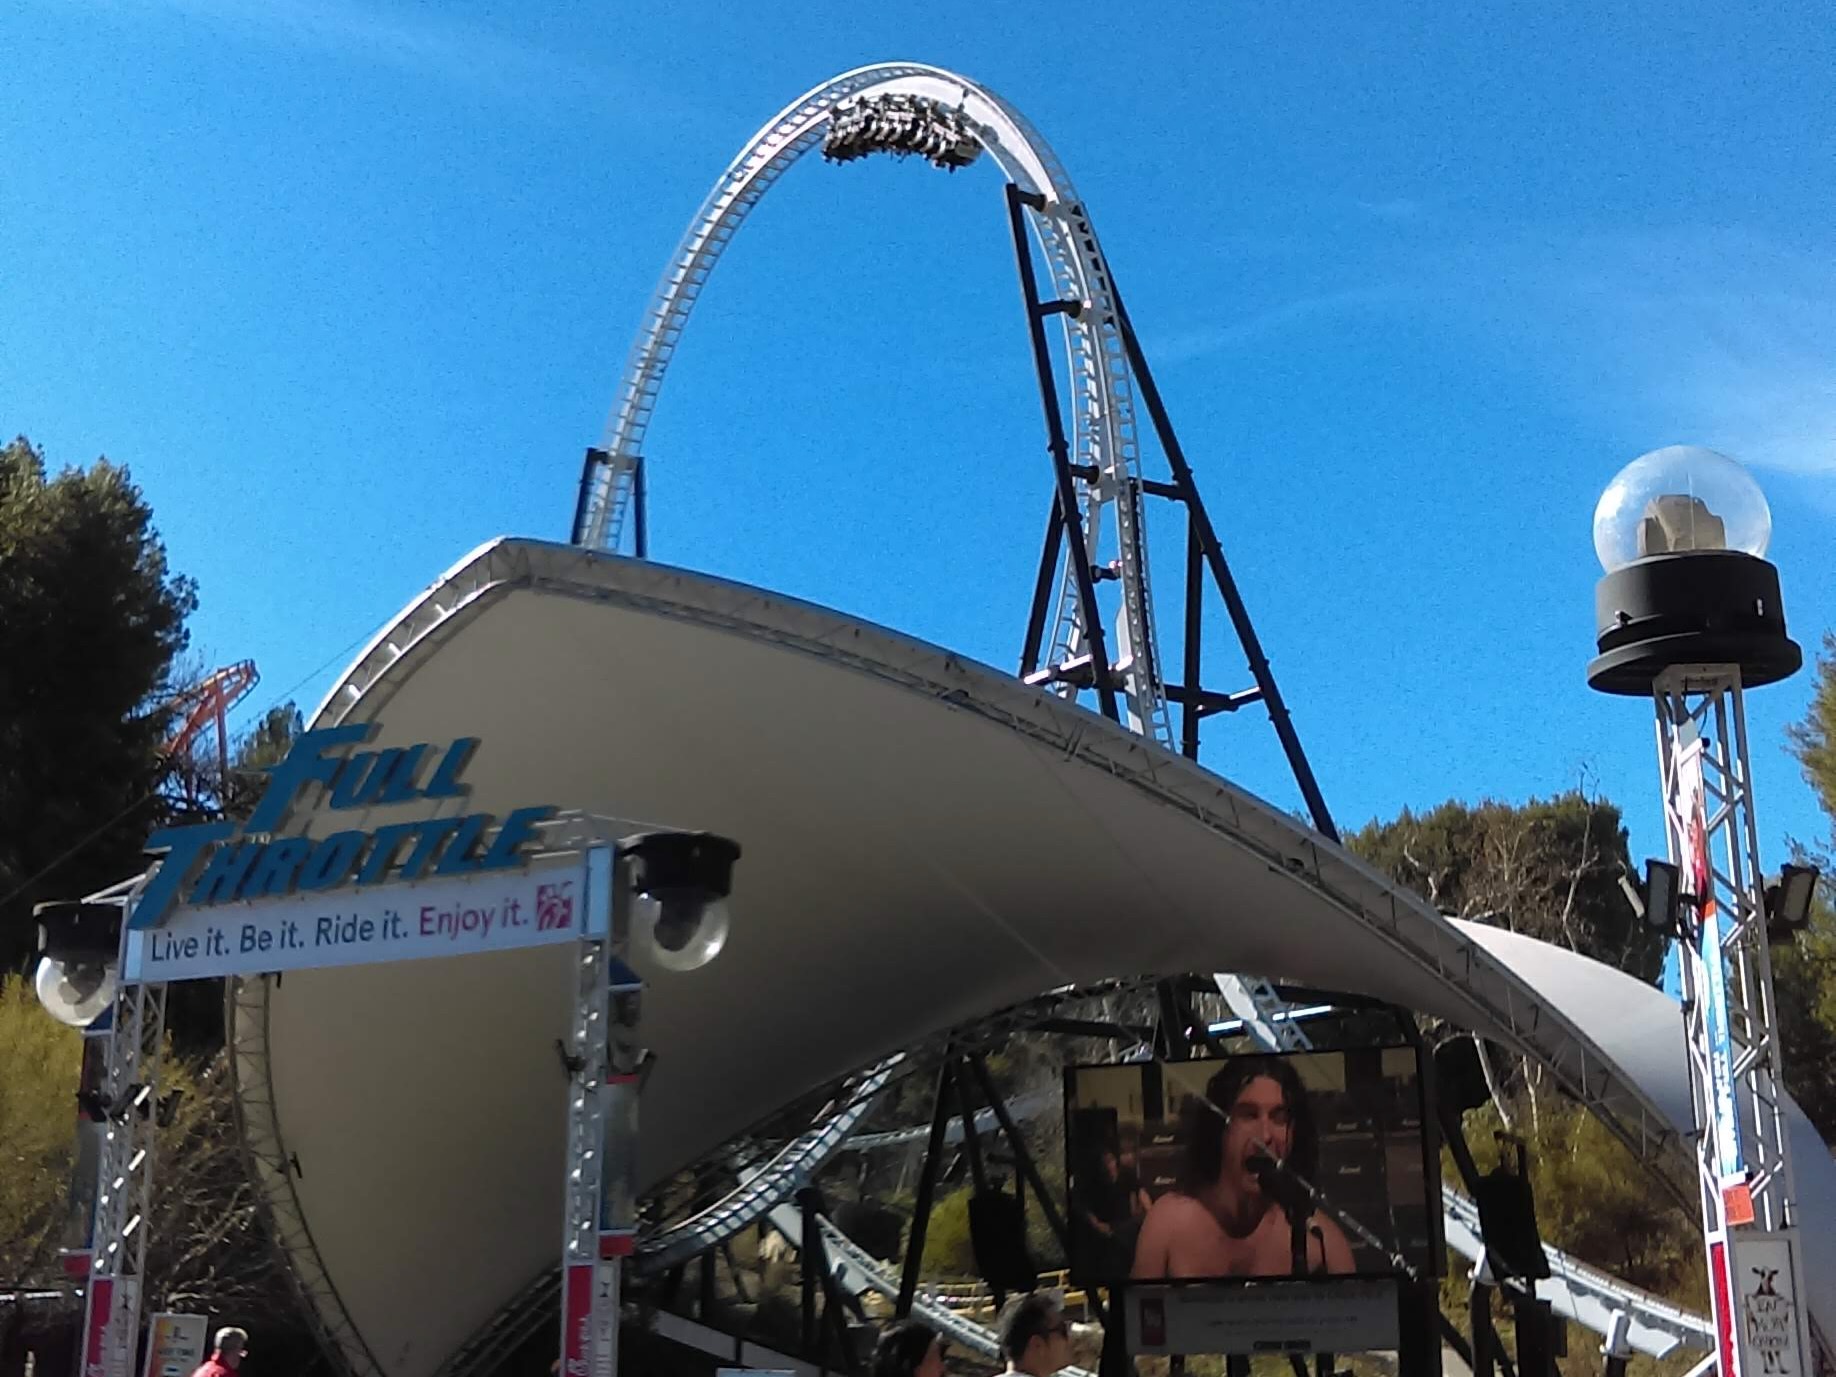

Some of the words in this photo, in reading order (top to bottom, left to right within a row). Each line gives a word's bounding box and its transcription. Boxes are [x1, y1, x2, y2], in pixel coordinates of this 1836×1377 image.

[244, 723, 480, 832] FULL
[127, 806, 559, 929] THROTTLE
[151, 931, 199, 961] Live
[206, 928, 230, 956] it.
[240, 924, 273, 953] Be
[281, 920, 304, 949] it.
[315, 914, 374, 946] Ride
[383, 910, 408, 939] it.
[419, 904, 495, 940] Enjoy
[502, 897, 528, 928] it.
